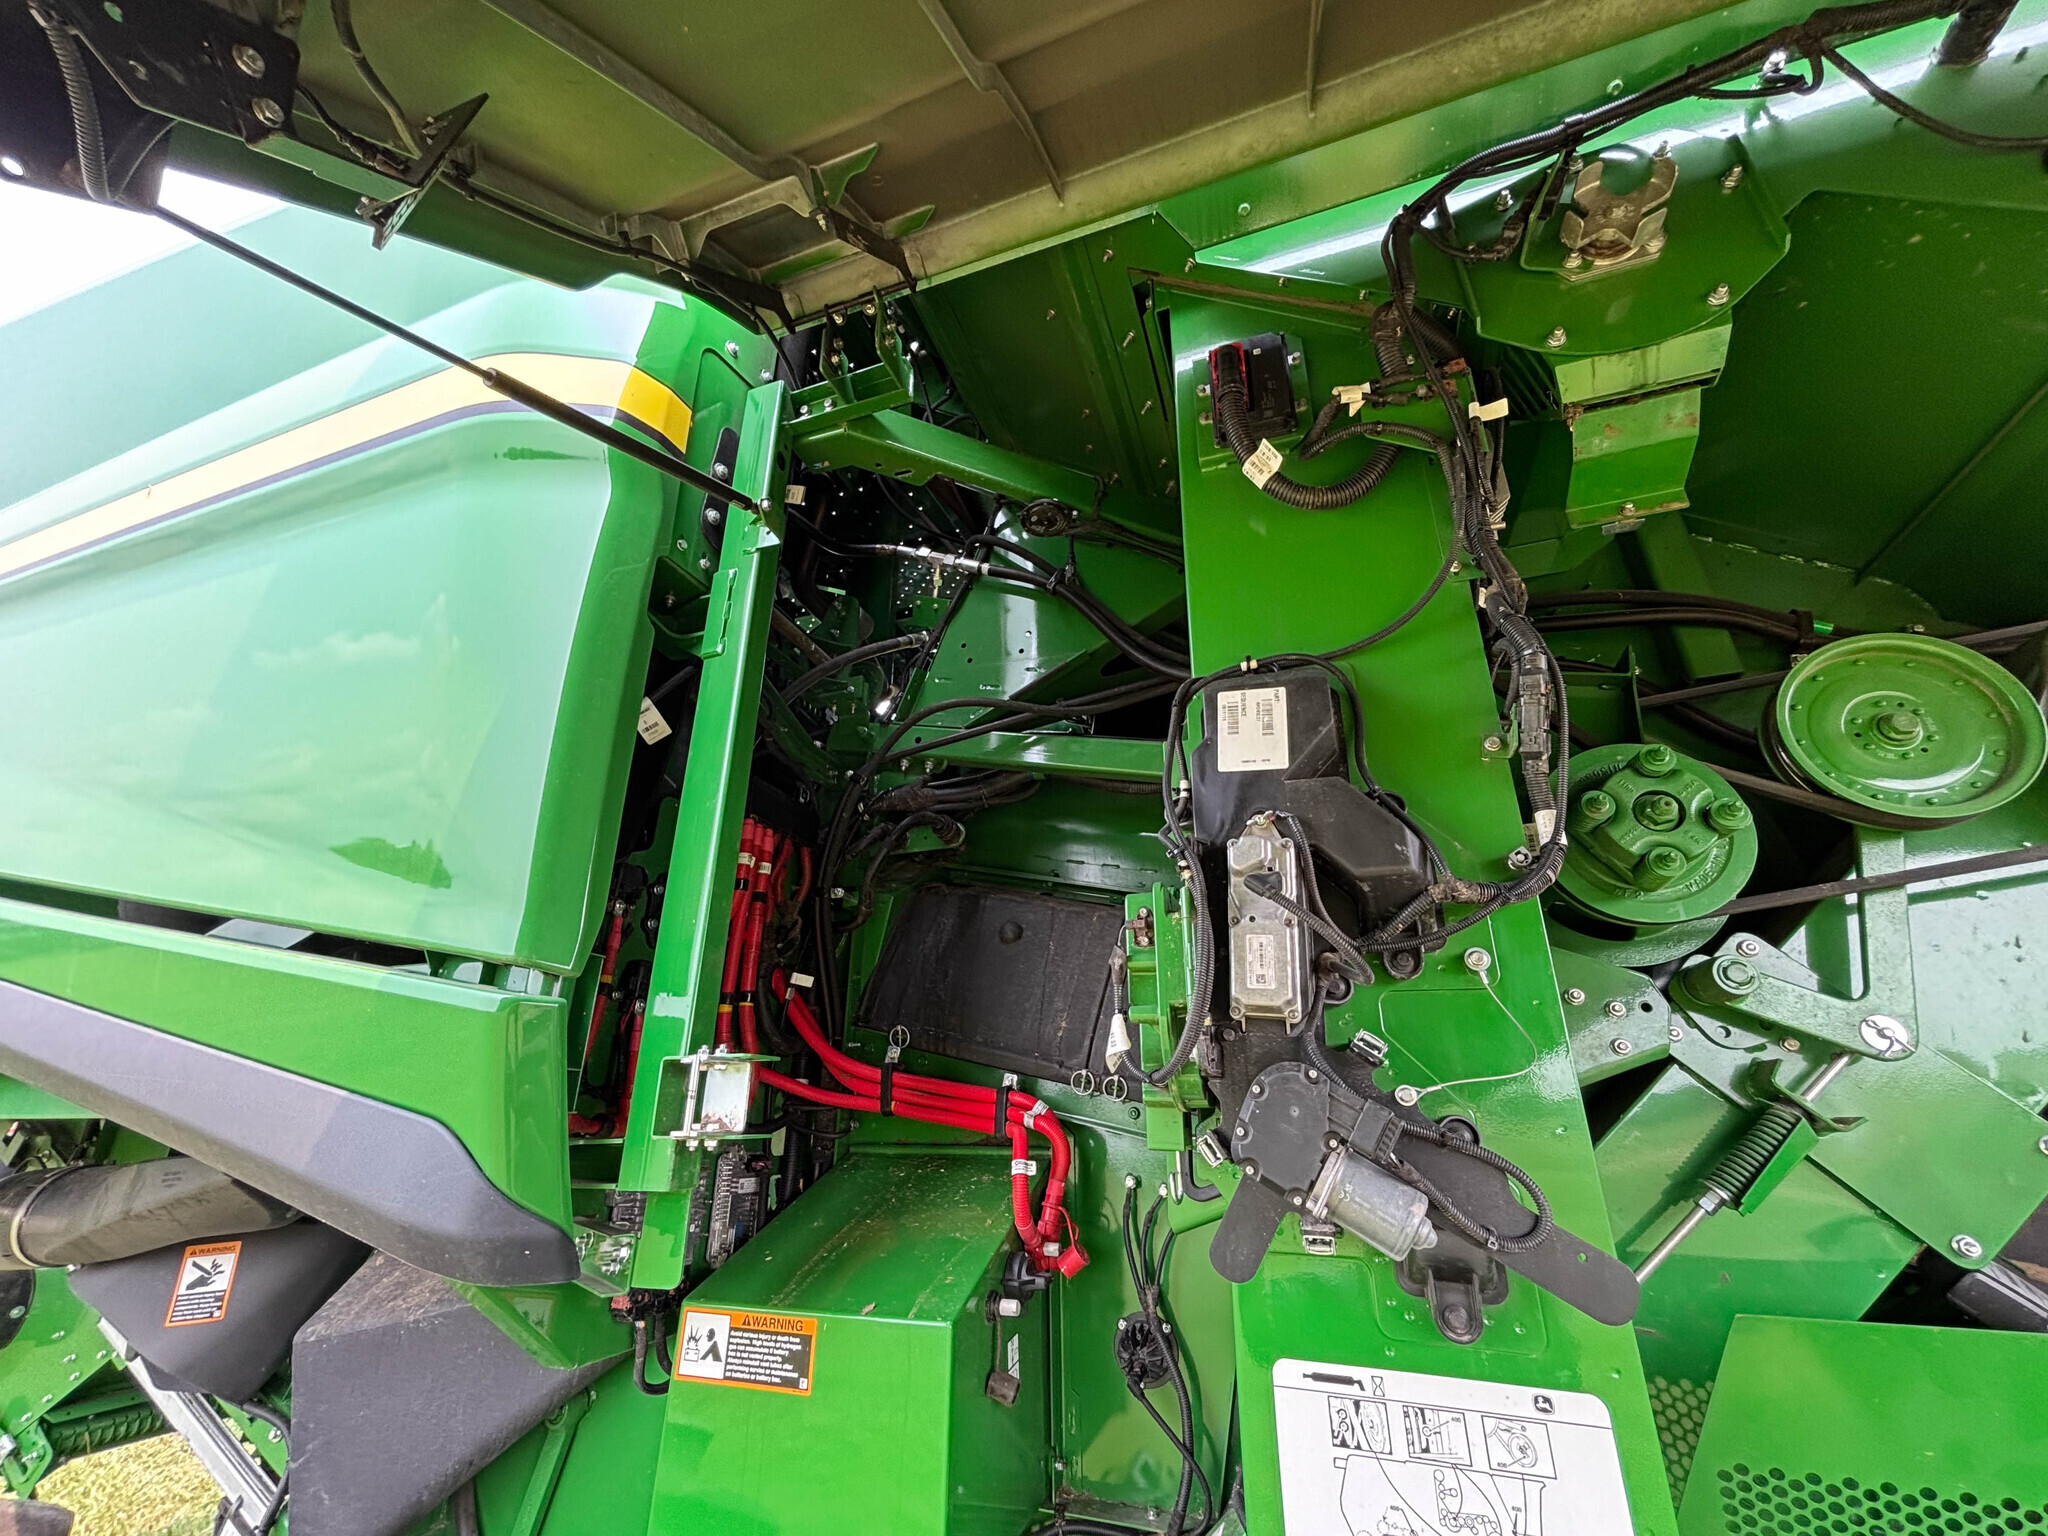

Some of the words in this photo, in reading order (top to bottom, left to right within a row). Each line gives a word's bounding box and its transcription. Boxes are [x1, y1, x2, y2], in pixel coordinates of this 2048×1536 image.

[198, 1245, 236, 1254] WARNING
[752, 1316, 803, 1332] WARNING
[781, 1343, 802, 1351] hydrogen
[756, 1375, 771, 1383] battery
